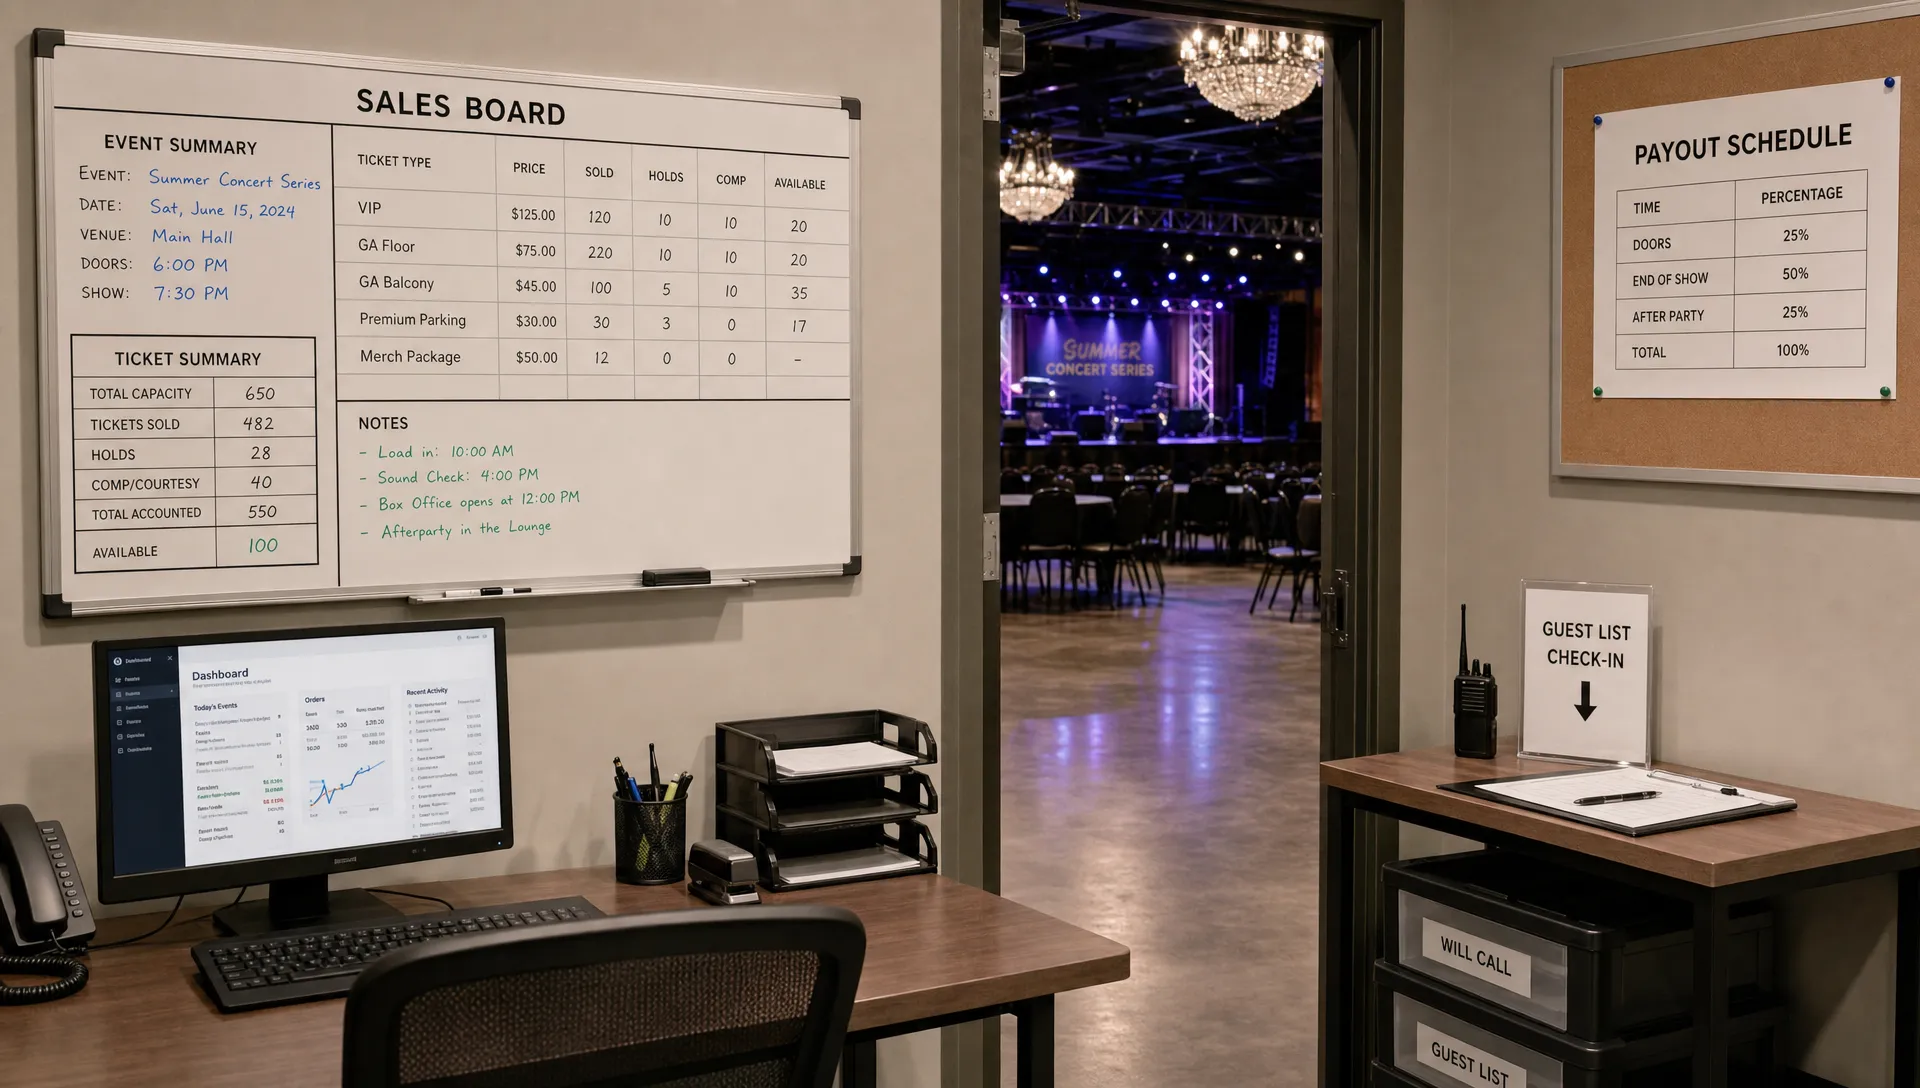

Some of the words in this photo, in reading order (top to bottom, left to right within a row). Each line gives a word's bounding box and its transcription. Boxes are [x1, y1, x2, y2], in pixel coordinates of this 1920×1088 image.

[357, 89, 450, 117] SALES
[466, 97, 565, 125] BOARD
[105, 134, 163, 151] EVENT
[170, 138, 257, 155] SUMMARY
[1636, 137, 1720, 165] PAYOUT
[1728, 123, 1851, 156] SCHEDULE
[358, 154, 399, 166] TICKET
[403, 157, 431, 168] TYPE
[514, 162, 545, 174] PRICE
[586, 167, 613, 177] SOLD
[80, 165, 130, 181] EVENT:
[150, 169, 209, 185] Summer
[220, 172, 273, 187] Concert
[281, 174, 320, 189] Series
[649, 171, 683, 182] HOLDS
[717, 175, 746, 185] COMP
[775, 178, 825, 190] AVAILABLE
[1762, 186, 1842, 204] PERCENTAGE
[79, 198, 121, 211] DATE:
[151, 199, 182, 217] Sat,
[191, 201, 224, 215] June
[234, 204, 252, 219] 15,
[260, 205, 294, 218] 2024
[358, 202, 381, 214] VIP
[1634, 201, 1660, 214] TIME
[512, 208, 555, 221] $125.00
[590, 211, 610, 223] 120
[660, 214, 671, 226] 10
[726, 217, 737, 229] 10
[791, 220, 807, 232] 20
[80, 229, 131, 241] VENUE:
[153, 229, 190, 242] Main
[202, 230, 232, 243] Hall
[1784, 229, 1809, 241] 25%
[359, 239, 378, 251] GA
[383, 240, 415, 252] Floor
[516, 244, 555, 256] $75.00
[1634, 238, 1671, 250] DOORS
[589, 246, 612, 259] 220
[660, 249, 671, 261] 10
[726, 251, 737, 263] 10
[81, 257, 132, 269] DOORS:
[154, 257, 194, 271] 6:00
[205, 258, 227, 272] PM
[791, 254, 807, 266] 20
[1633, 275, 1654, 286] END
[1658, 274, 1672, 285] OF
[1675, 272, 1708, 284] SHOW
[1783, 267, 1808, 280] 50%
[360, 275, 379, 287] GA
[384, 276, 434, 292] Balcony
[516, 279, 556, 292] $45.00
[592, 282, 611, 294] 100
[663, 283, 670, 295] 5
[82, 286, 128, 298] SHOW:
[154, 286, 195, 300] 7:30
[205, 286, 228, 300] PM
[726, 285, 737, 297] 10
[792, 287, 807, 299] 35
[1633, 311, 1665, 322] AFTER
[1670, 310, 1704, 321] PARTY
[1783, 306, 1808, 318] 25%
[361, 313, 415, 325] Premium
[420, 313, 465, 329] Parking
[517, 315, 556, 327] $30.00
[594, 316, 609, 328] 30
[663, 317, 670, 329] 3
[728, 319, 735, 331] 0
[793, 320, 806, 332] 17
[1063, 338, 1141, 361] SUMMER
[1632, 347, 1666, 358] TOTAL
[1778, 344, 1809, 356] 100%
[115, 352, 173, 365] TICKET
[180, 352, 261, 366] SUMMARY
[361, 350, 402, 362] Merch
[408, 350, 460, 366] Package
[517, 351, 557, 364] $50.00
[596, 352, 608, 363] 12
[663, 352, 671, 364] 0
[728, 353, 736, 365] 0
[1046, 362, 1106, 376] CONCERT
[1111, 364, 1154, 376] SERIES
[90, 388, 128, 399] TOTAL
[132, 388, 191, 399] CAPACITY
[246, 386, 275, 400] 650
[91, 419, 143, 430] TICKETS
[148, 419, 179, 430] SOLD
[244, 417, 274, 430] 482
[359, 417, 408, 429] NOTES
[92, 449, 135, 460] HOLDS
[251, 446, 270, 460] 28
[379, 446, 412, 458] Load
[423, 447, 438, 457] in:
[452, 446, 486, 457] 10:00
[492, 445, 513, 457] AM
[251, 476, 271, 489] 40
[379, 471, 417, 484] Sound
[427, 470, 469, 483] Check:
[481, 470, 512, 482] 4:00
[519, 468, 538, 480] PM
[92, 478, 199, 491] COMP/COURTESY
[380, 497, 403, 511] Box
[412, 496, 452, 509] Office
[460, 499, 493, 512] opens
[501, 495, 513, 505] at
[523, 493, 555, 504] 12:00
[561, 491, 579, 503] PM
[92, 509, 128, 520] TOTAL
[132, 507, 201, 519] ACCOUNTED
[249, 505, 276, 518] 550
[382, 524, 451, 541] Afterparty
[461, 524, 471, 535] in
[480, 522, 500, 533] the
[510, 520, 551, 535] Lounge
[93, 546, 157, 558] AVAILABLE
[250, 538, 278, 553] 100
[1543, 621, 1593, 638] GUEST
[1599, 625, 1631, 640] LIST
[1548, 649, 1623, 668] CHECK-IN
[192, 668, 248, 680] Dashboard
[1441, 936, 1472, 961] WILL
[1477, 951, 1511, 976] CALL
[1432, 1042, 1475, 1072] GUEST
[1480, 1063, 1509, 1088] LIST
